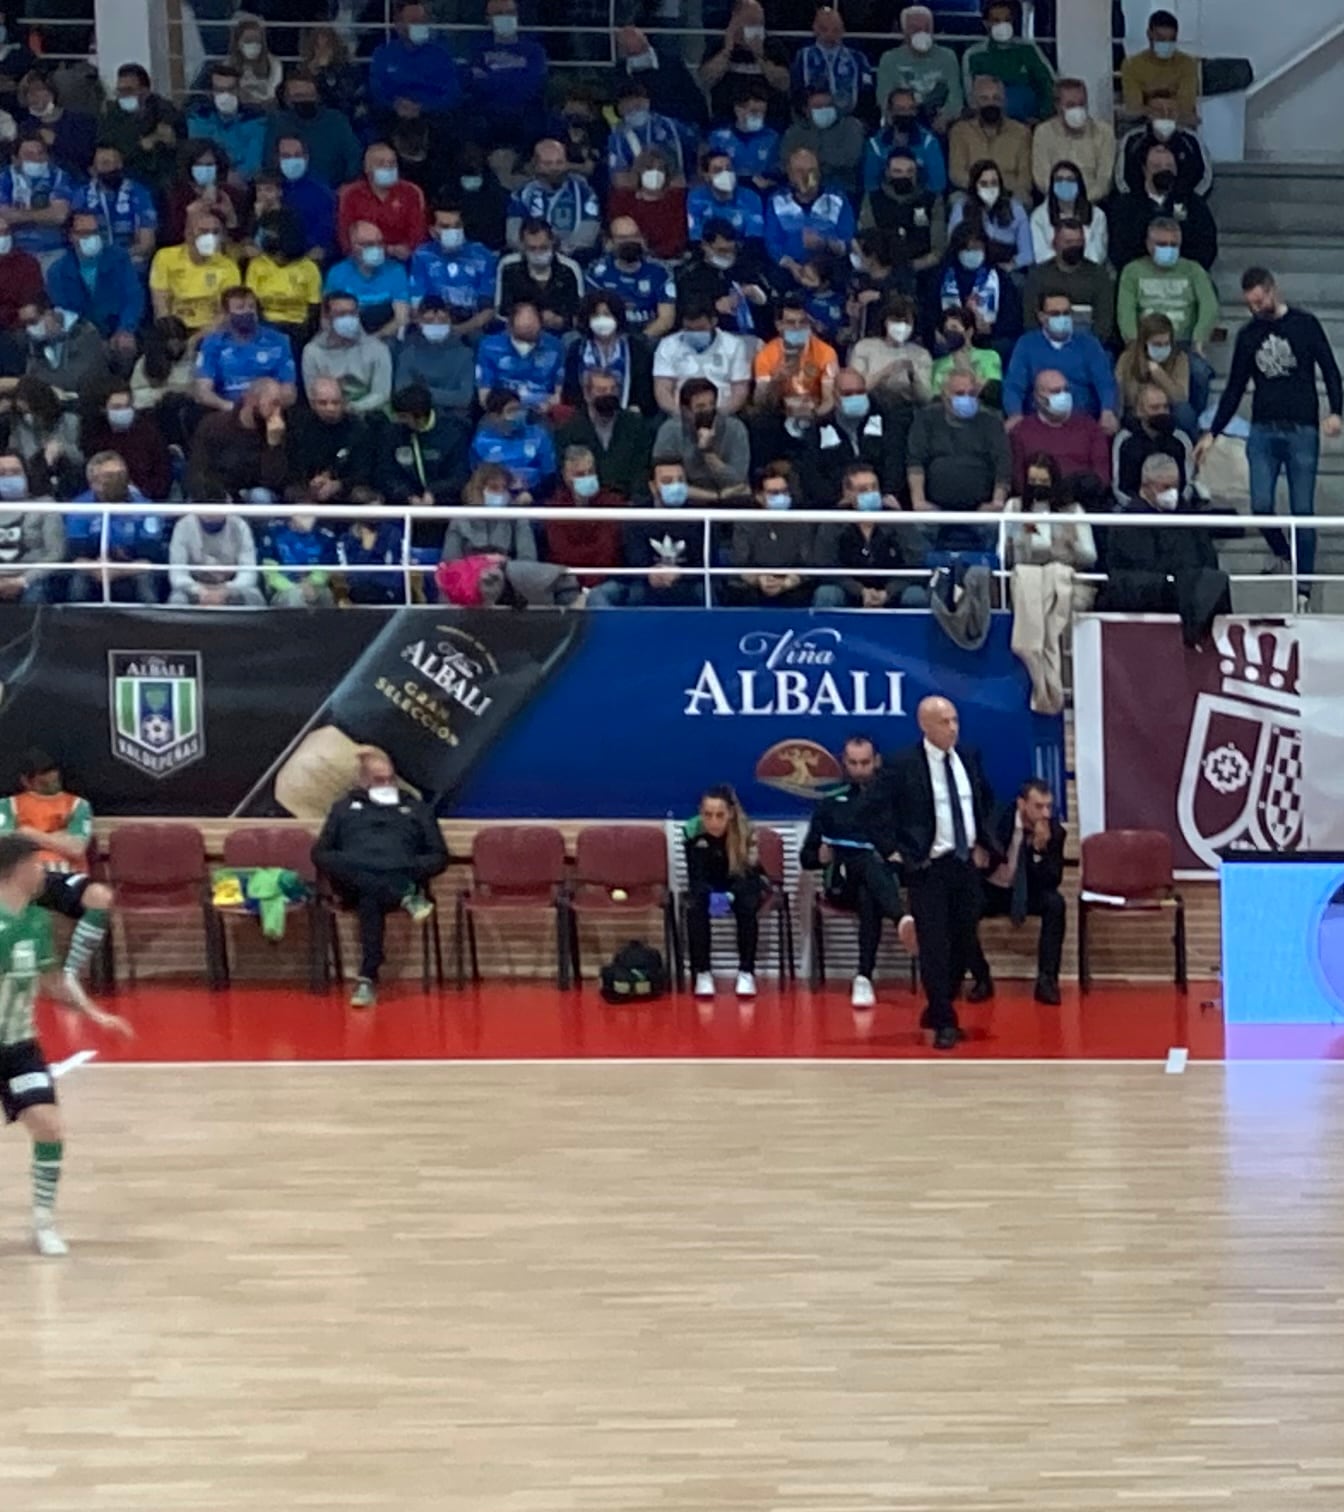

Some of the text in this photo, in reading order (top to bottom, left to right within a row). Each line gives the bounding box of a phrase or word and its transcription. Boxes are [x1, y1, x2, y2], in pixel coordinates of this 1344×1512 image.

[739, 627, 843, 669] Viña
[400, 639, 493, 716] ALBALI
[684, 659, 908, 716] ALBALI
